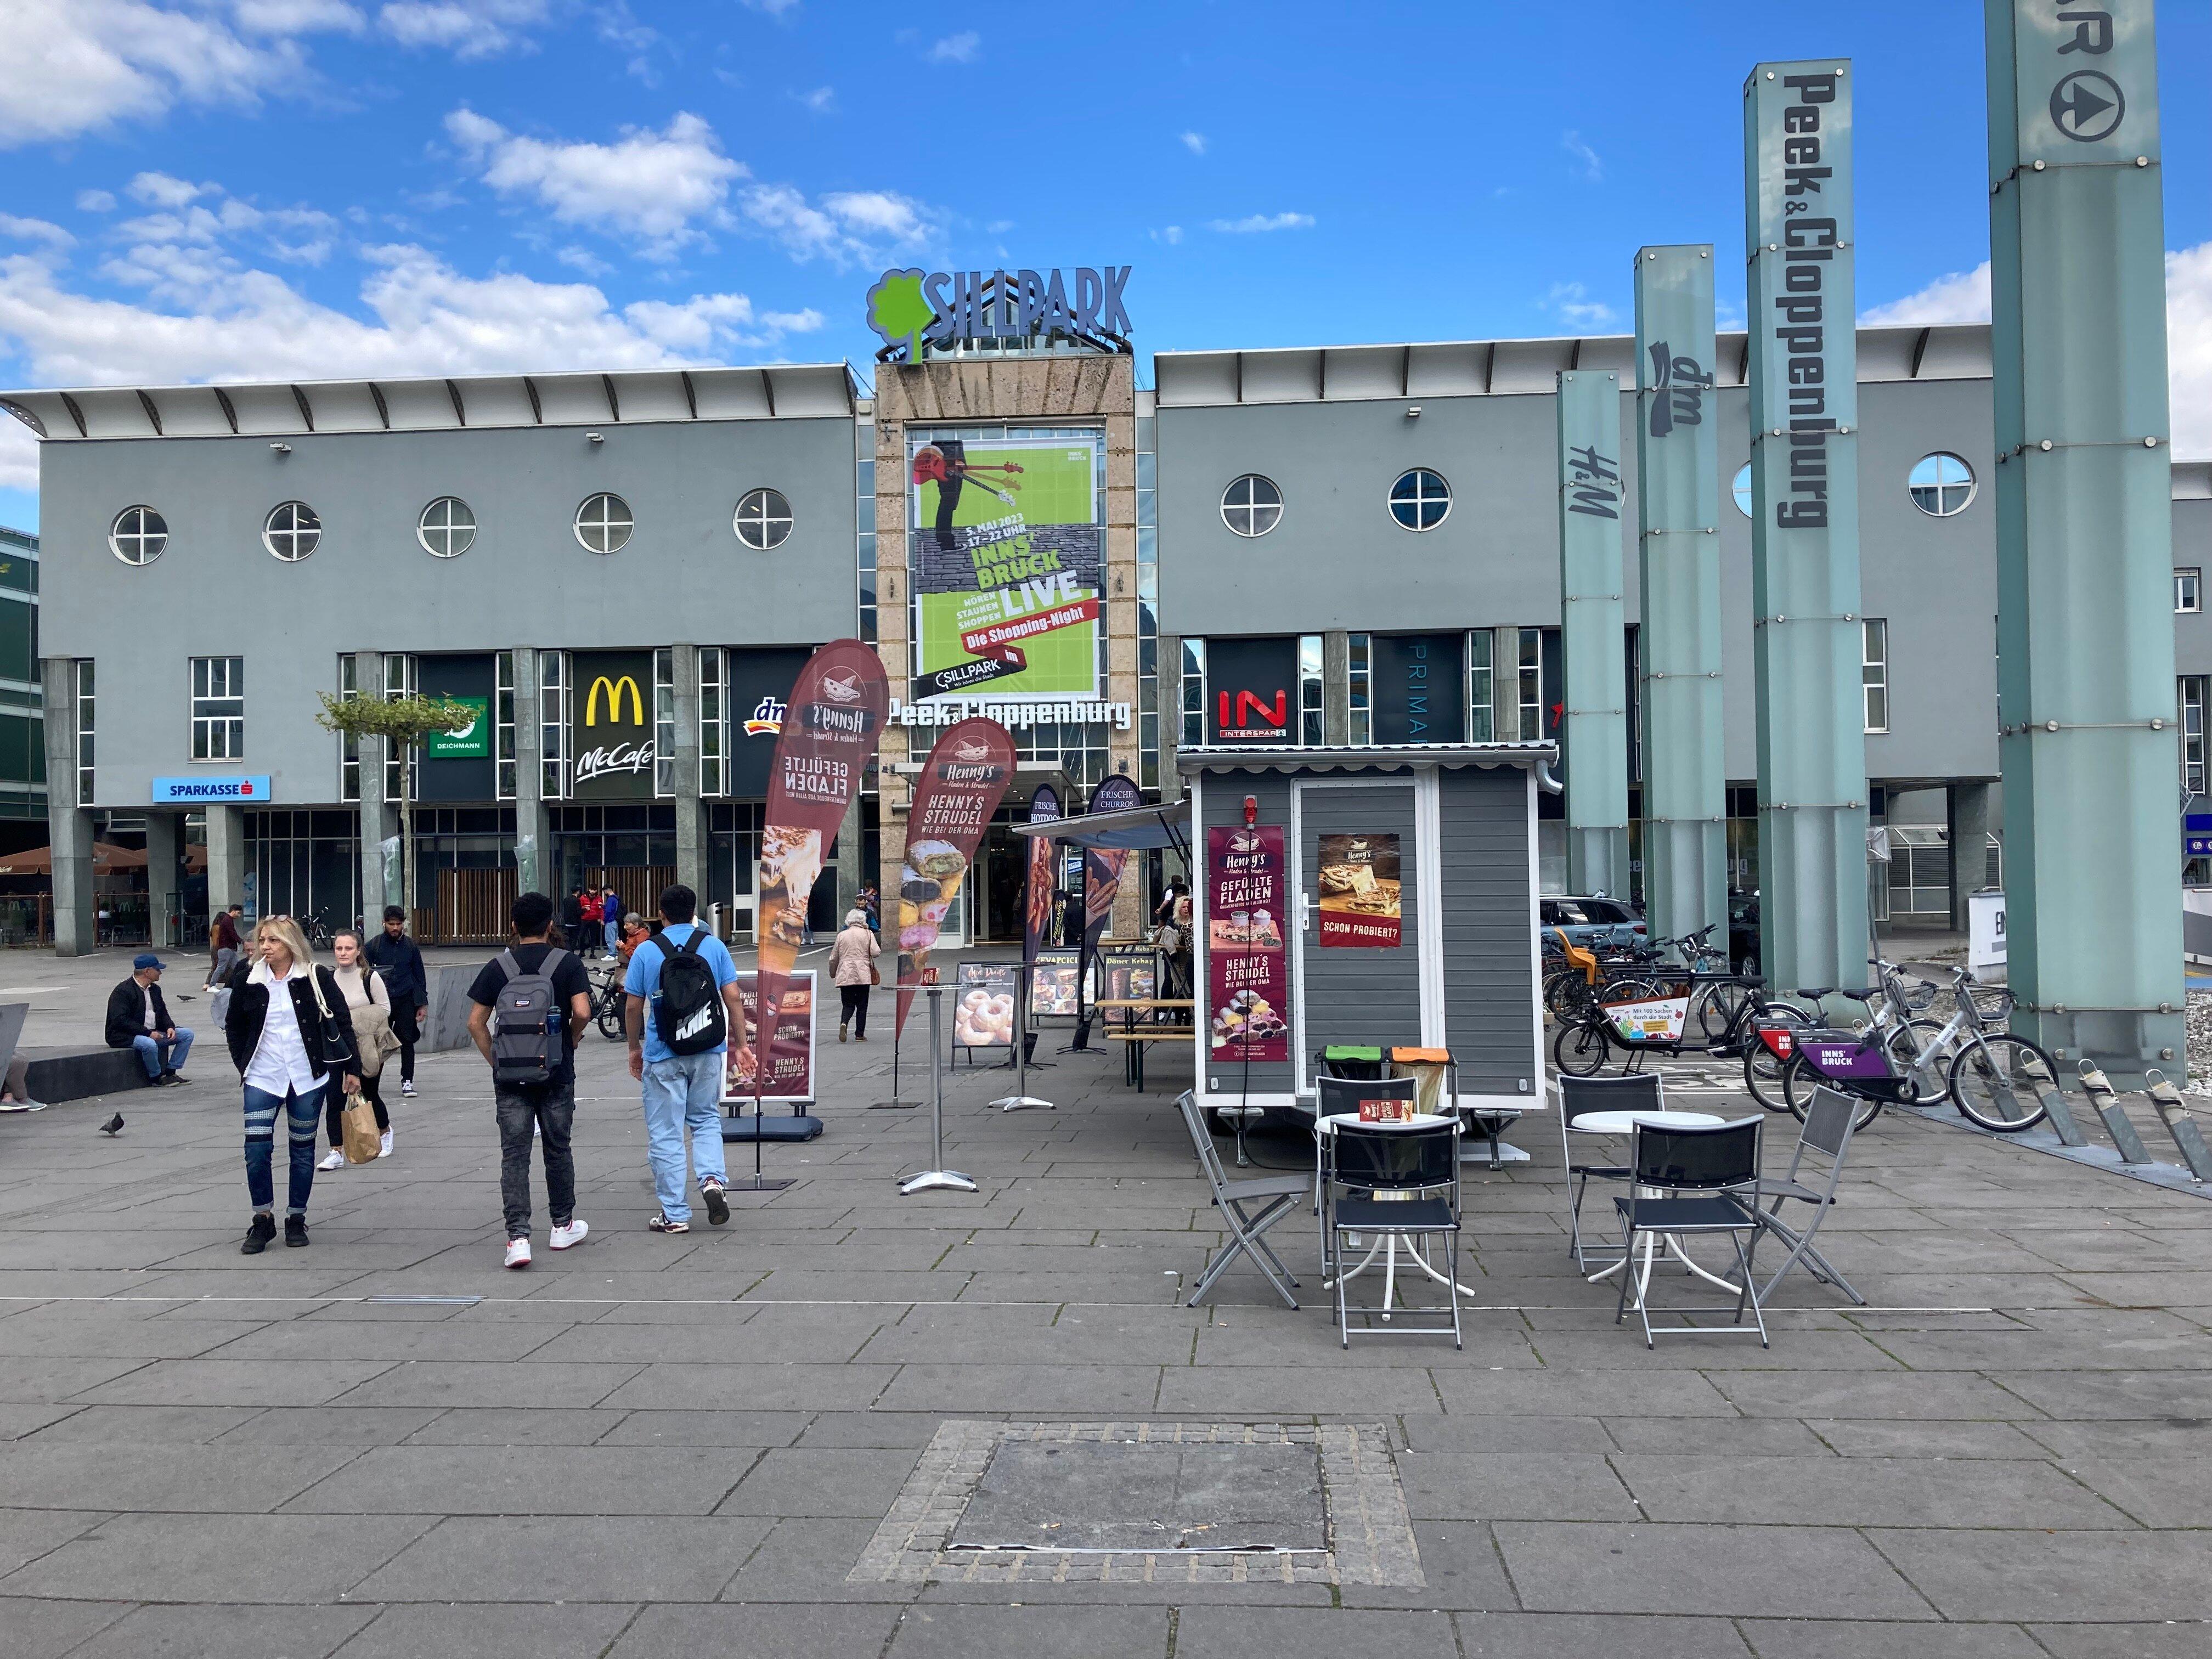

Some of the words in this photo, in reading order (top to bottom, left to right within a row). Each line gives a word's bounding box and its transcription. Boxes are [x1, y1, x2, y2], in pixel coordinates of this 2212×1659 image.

[2056, 0, 2114, 54] R
[1784, 74, 1836, 195] Peek
[1785, 201, 1808, 215] &
[924, 266, 1132, 338] SILLPARK
[1775, 217, 1837, 529] Cloppenburg
[1672, 357, 1713, 425] dm
[966, 527, 976, 537] 5.
[977, 520, 997, 533] MAI
[998, 512, 1024, 527] 2023
[1003, 523, 1028, 537] UHR
[971, 532, 1035, 568] INNS'
[976, 549, 1062, 589] BRUCK
[963, 592, 996, 607] HÖREN
[999, 569, 1082, 617] LIVE
[957, 601, 999, 620] STAUNEN
[958, 611, 1002, 630] SHOPPEN
[966, 634, 988, 649] Die
[988, 606, 1085, 643] Shopping-Night
[1005, 650, 1019, 662] im
[943, 658, 1001, 684] SILLPARK
[1409, 645, 1428, 744] PRIMA
[885, 698, 950, 726] Peek
[1219, 689, 1286, 727] IN
[576, 740, 654, 776] McCafé
[947, 764, 995, 781] Henny's
[170, 785, 239, 795] SPARKASSE
[1035, 802, 1057, 810] FRISCHE
[924, 810, 981, 825] STRUDEL
[1347, 850, 1372, 860] Henny's
[1221, 876, 1272, 891] GEFÜLLTE
[1221, 887, 1271, 904] FLADEN
[1324, 921, 1350, 934] SCHON
[1353, 924, 1398, 938] PROBIERT?
[1131, 957, 1154, 966] Kebap
[1226, 967, 1270, 981] STRUDEL
